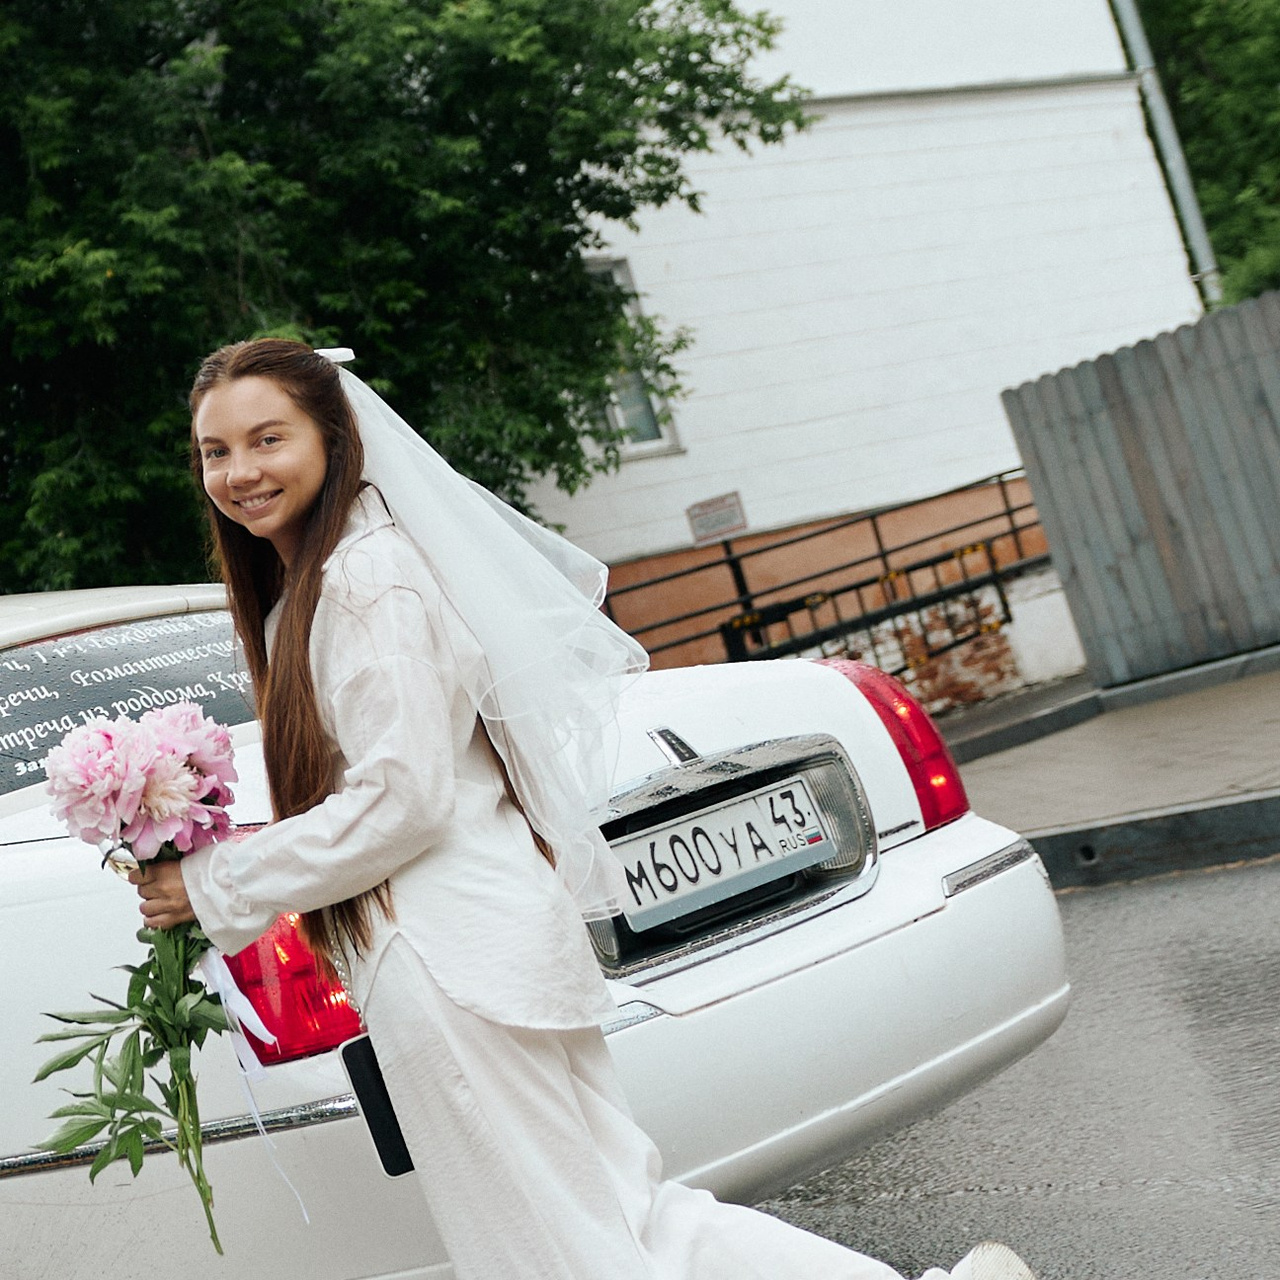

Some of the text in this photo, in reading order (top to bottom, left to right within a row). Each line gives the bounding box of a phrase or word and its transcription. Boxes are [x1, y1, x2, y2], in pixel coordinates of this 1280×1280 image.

[111, 682, 216, 718] роддома,
[769, 790, 807, 833] 43
[779, 834, 807, 854] RUS
